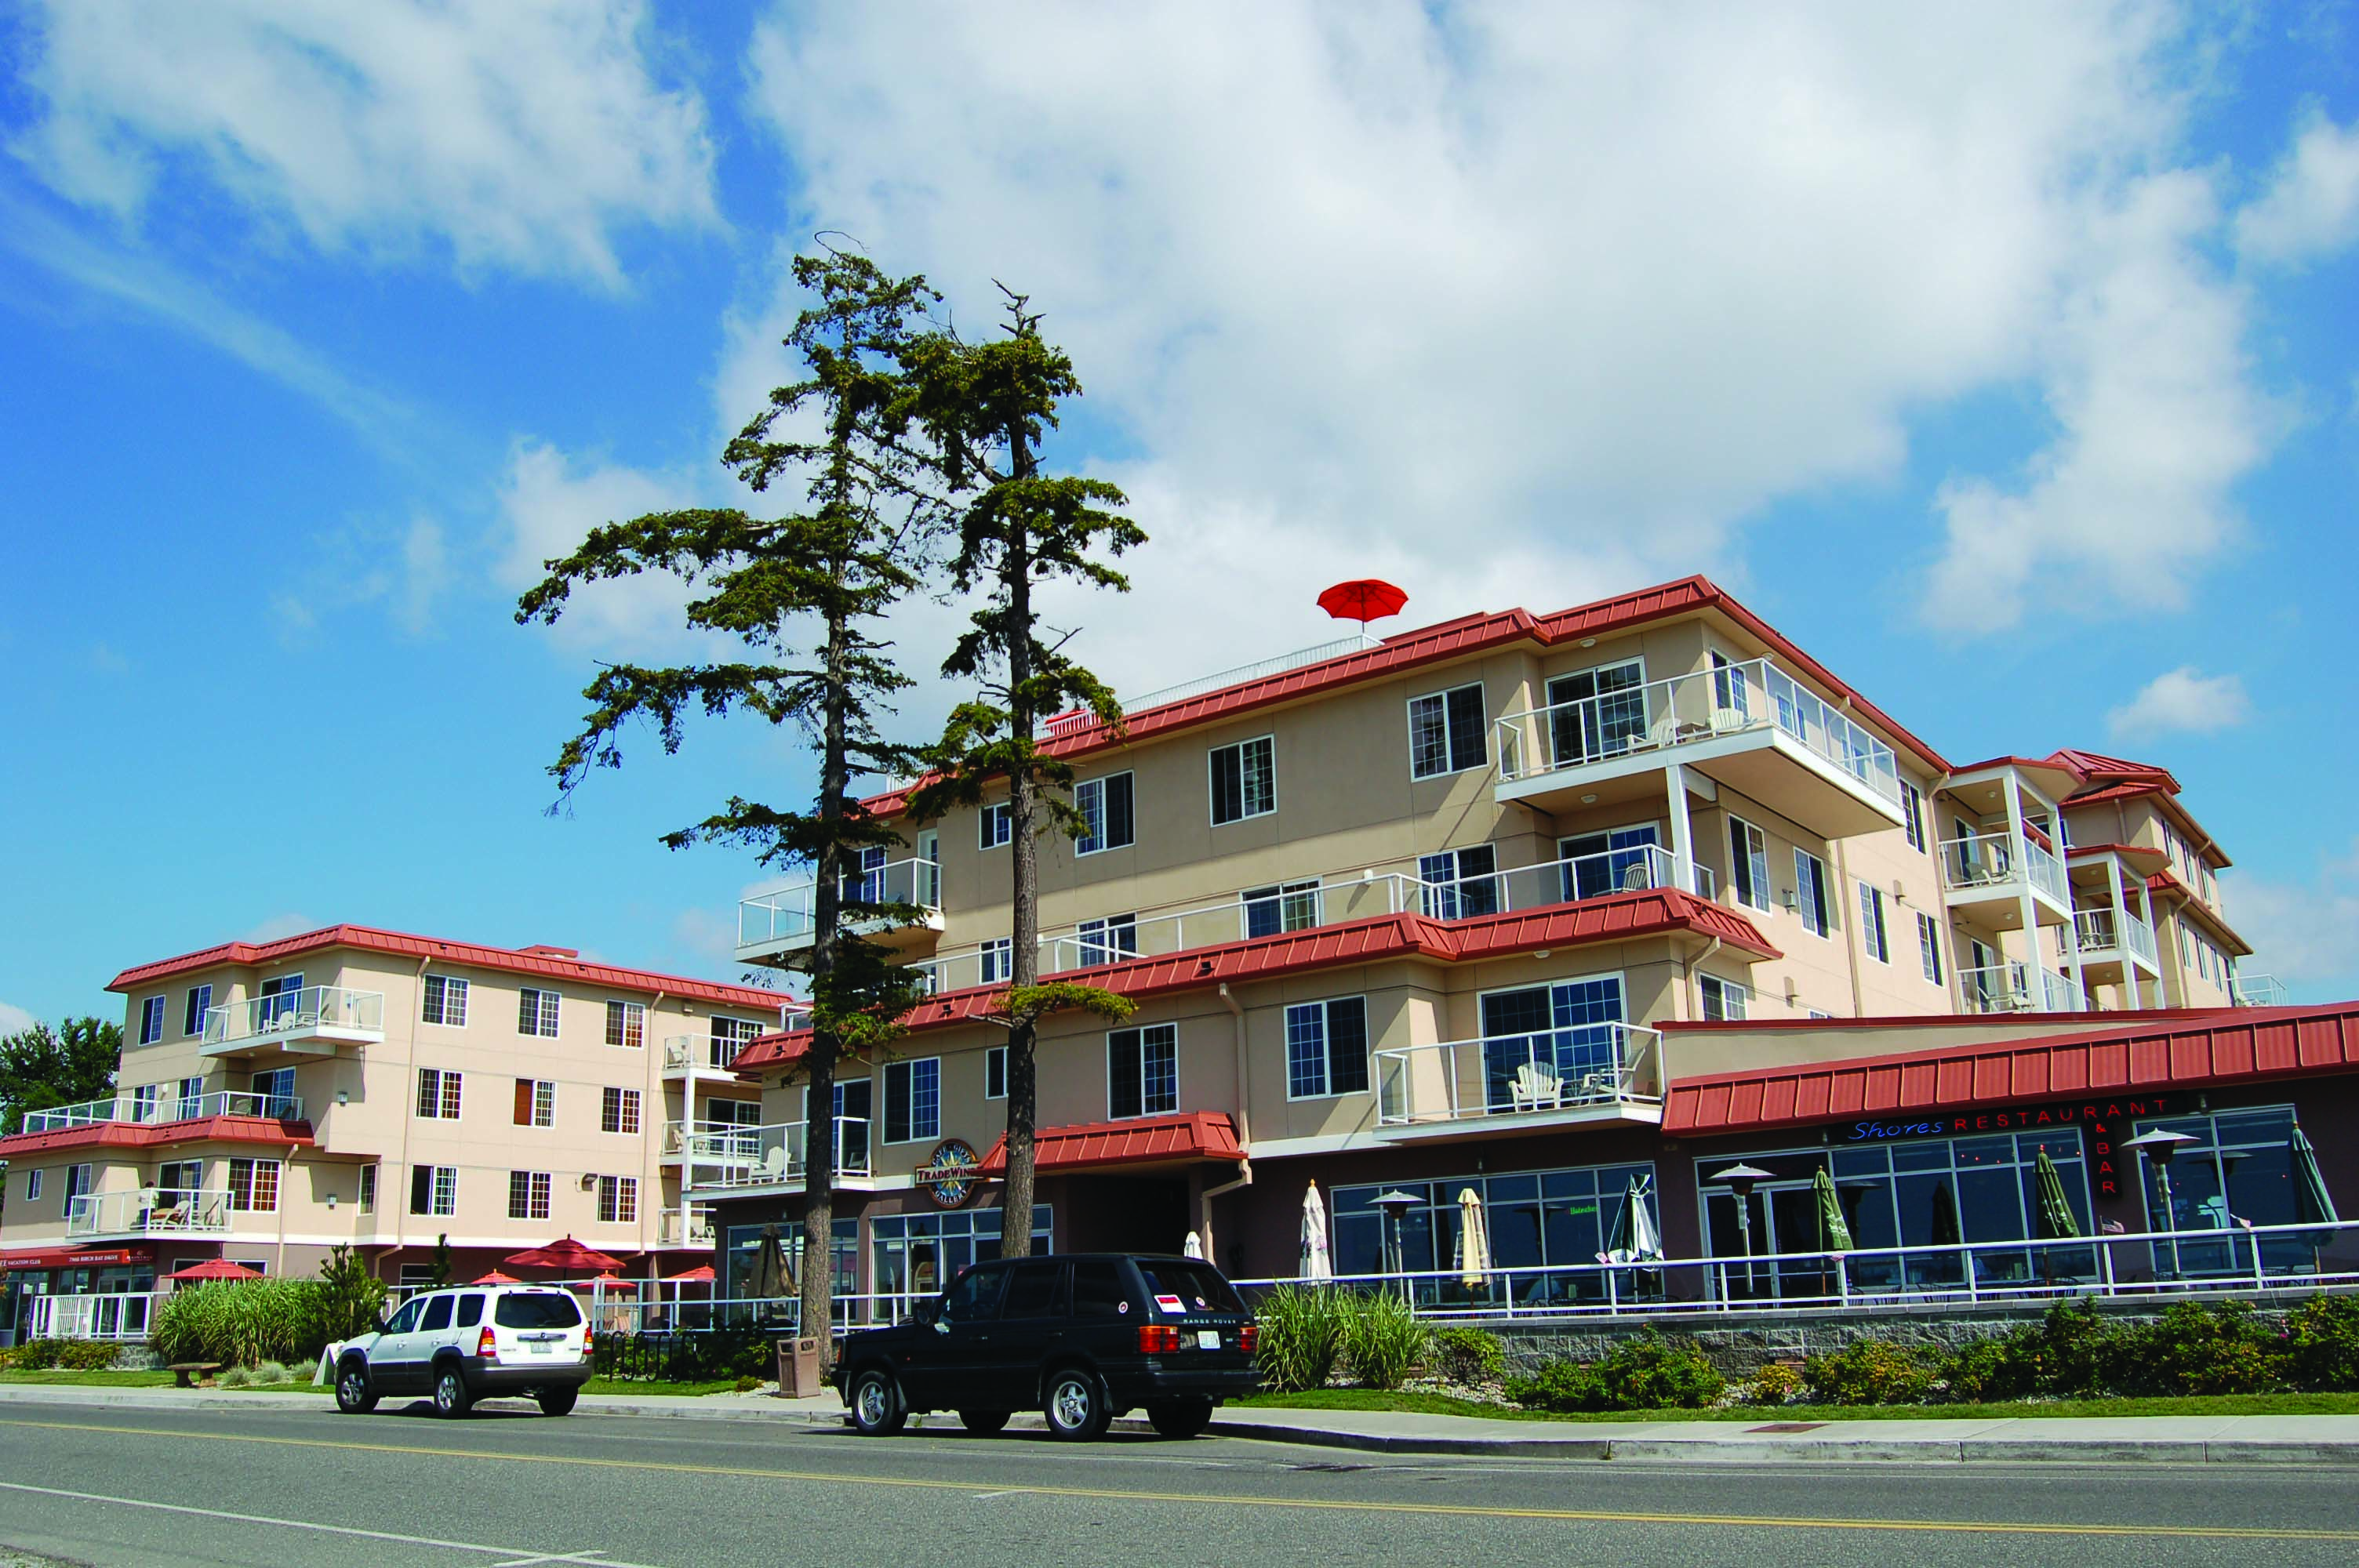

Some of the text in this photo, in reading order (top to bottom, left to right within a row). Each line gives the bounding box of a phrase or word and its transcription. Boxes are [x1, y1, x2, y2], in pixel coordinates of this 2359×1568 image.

[1848, 1099, 2168, 1139] Shores RESTAURANT
[2095, 1123, 2116, 1194] & BAR
[918, 1166, 979, 1181] TRADEWIN
[935, 1189, 967, 1204] GALLERY
